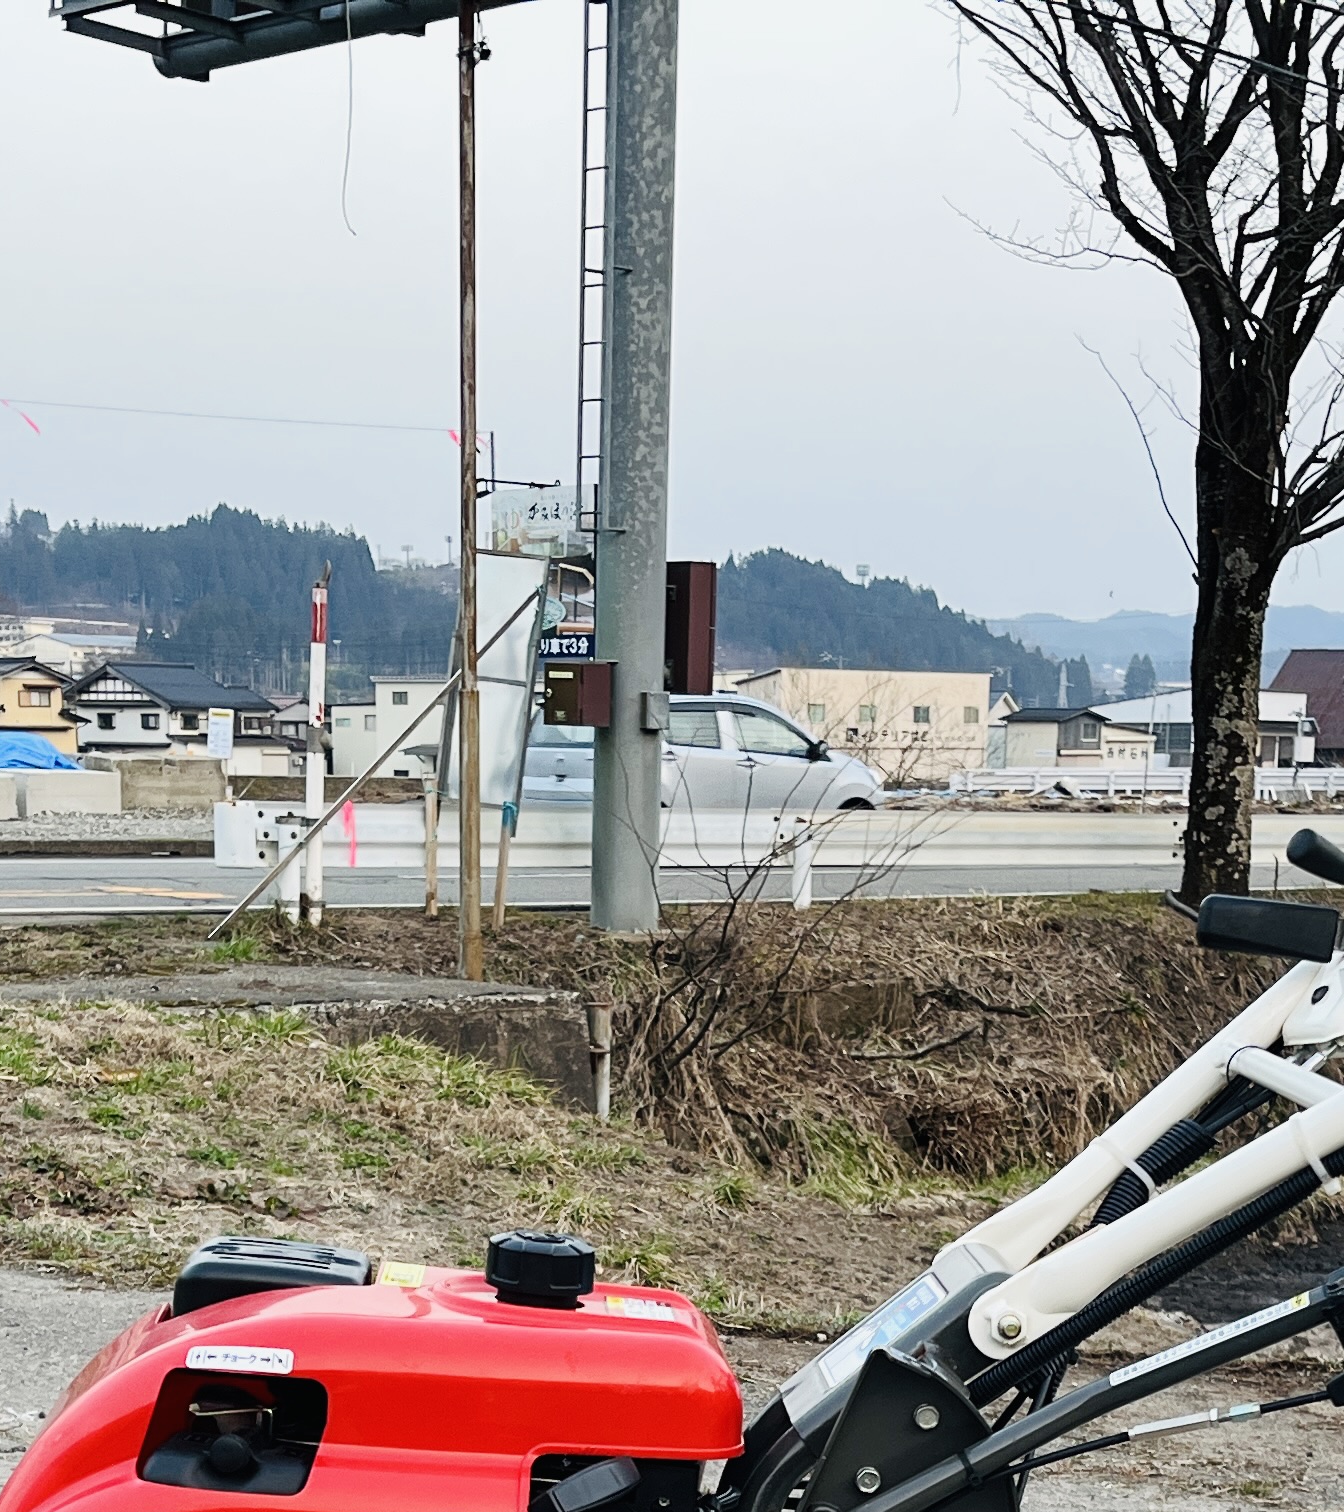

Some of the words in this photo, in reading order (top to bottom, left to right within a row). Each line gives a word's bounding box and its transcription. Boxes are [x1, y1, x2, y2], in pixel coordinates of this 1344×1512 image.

[538, 637, 589, 655] り車で3分
[222, 1353, 257, 1364] チョーク
